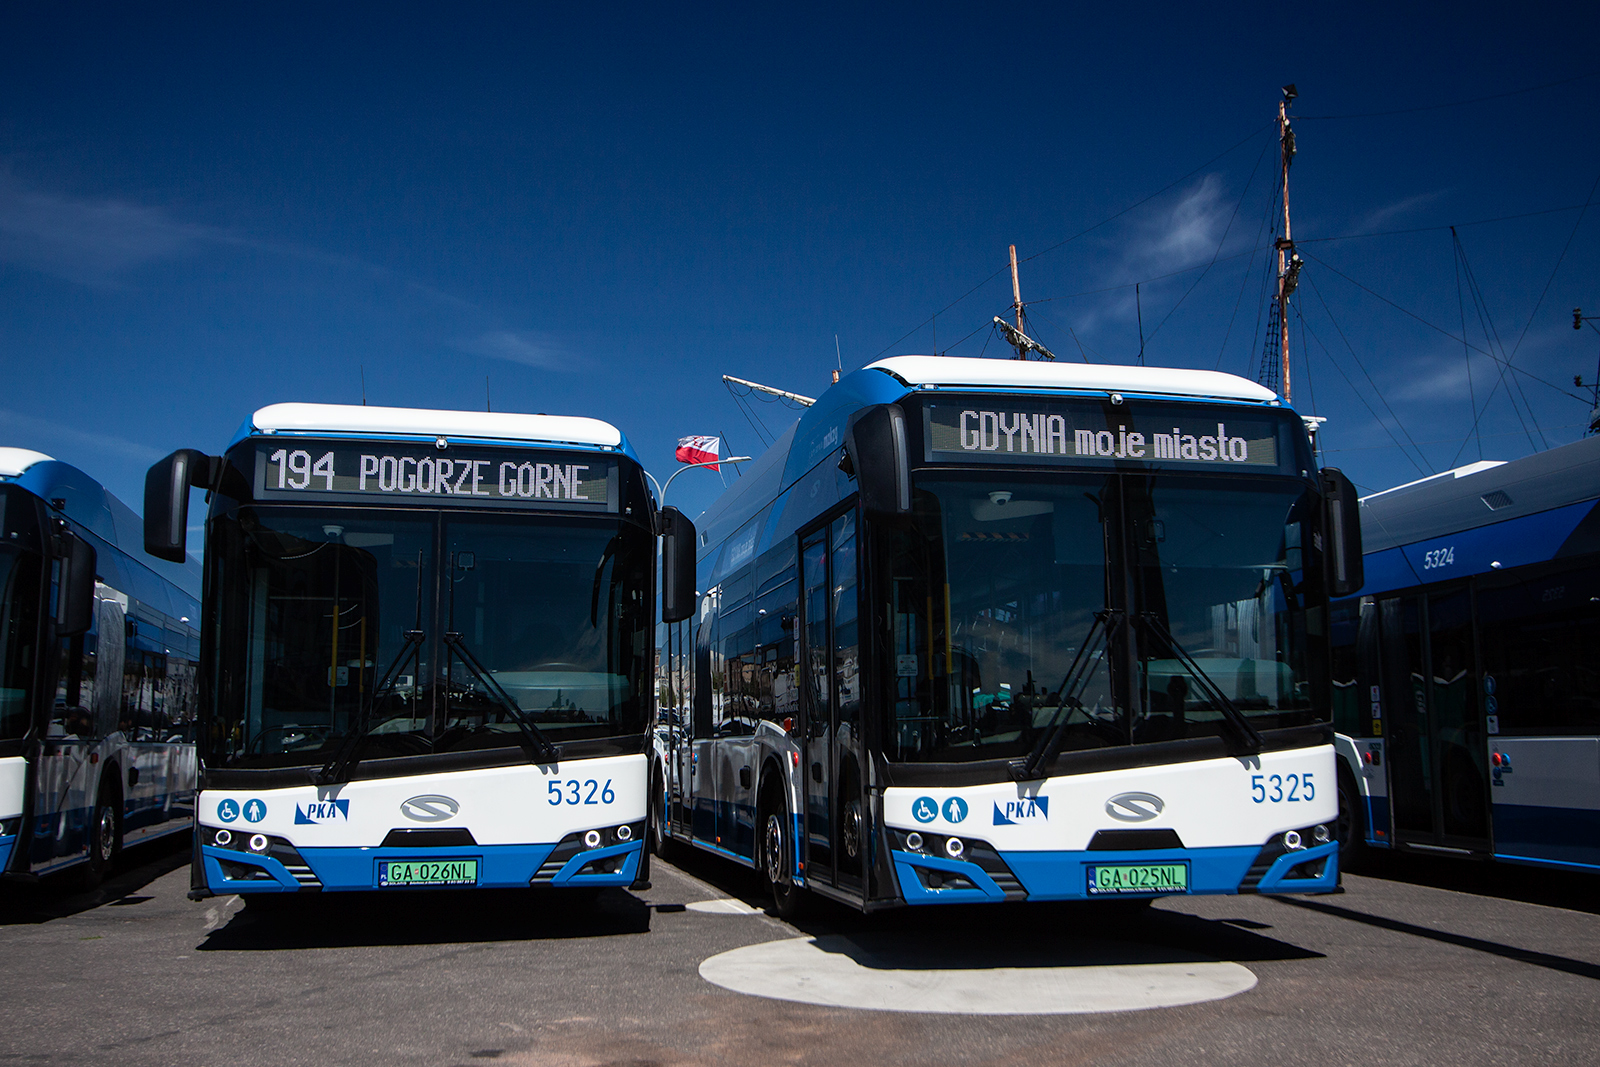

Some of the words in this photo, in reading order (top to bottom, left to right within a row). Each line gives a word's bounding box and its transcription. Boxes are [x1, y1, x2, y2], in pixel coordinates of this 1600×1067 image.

[960, 410, 1066, 453] GDYNIA
[1074, 425, 1145, 459] moje
[1153, 423, 1248, 462] miasto
[270, 449, 335, 490] 194
[359, 455, 491, 496] POGÓRZE
[499, 460, 589, 500] GÓRNE
[1424, 546, 1454, 570] 5324
[547, 779, 615, 806] 5326
[1251, 773, 1315, 803] 5325
[307, 803, 336, 819] PKA
[1006, 800, 1036, 819] PKA
[391, 864, 413, 881] GA
[420, 863, 472, 880] 026NL
[1100, 868, 1122, 887] GA
[1129, 867, 1181, 886] 025NL
